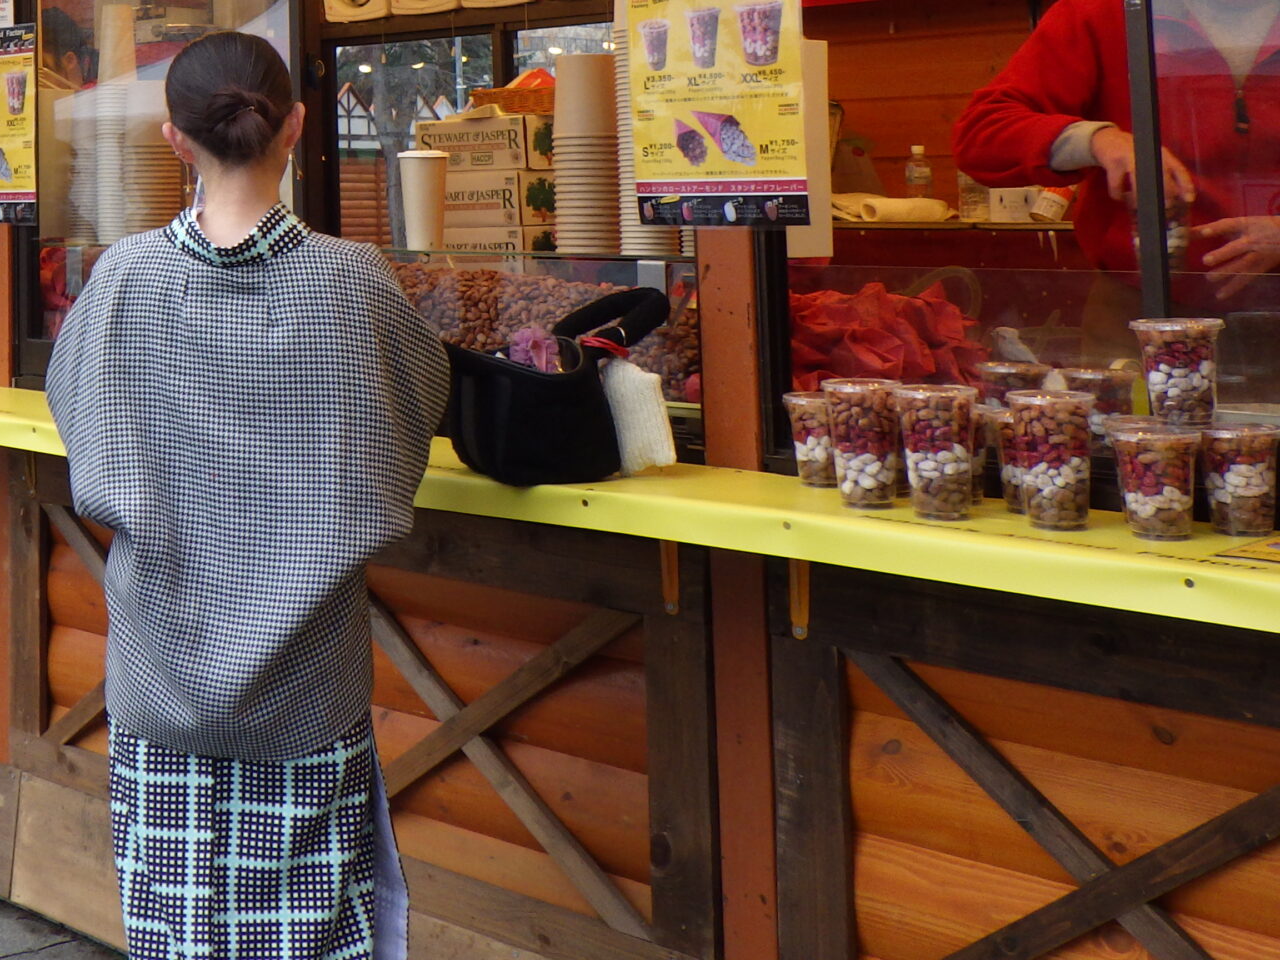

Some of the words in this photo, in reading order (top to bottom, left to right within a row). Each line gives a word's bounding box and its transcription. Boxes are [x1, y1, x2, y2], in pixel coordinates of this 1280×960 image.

[687, 76, 700, 87] XL
[741, 72, 762, 84] XXL
[421, 131, 472, 151] STEWART
[480, 129, 521, 150] JASPER
[642, 146, 650, 158] S
[759, 143, 769, 155] M
[475, 188, 515, 209] JASPER
